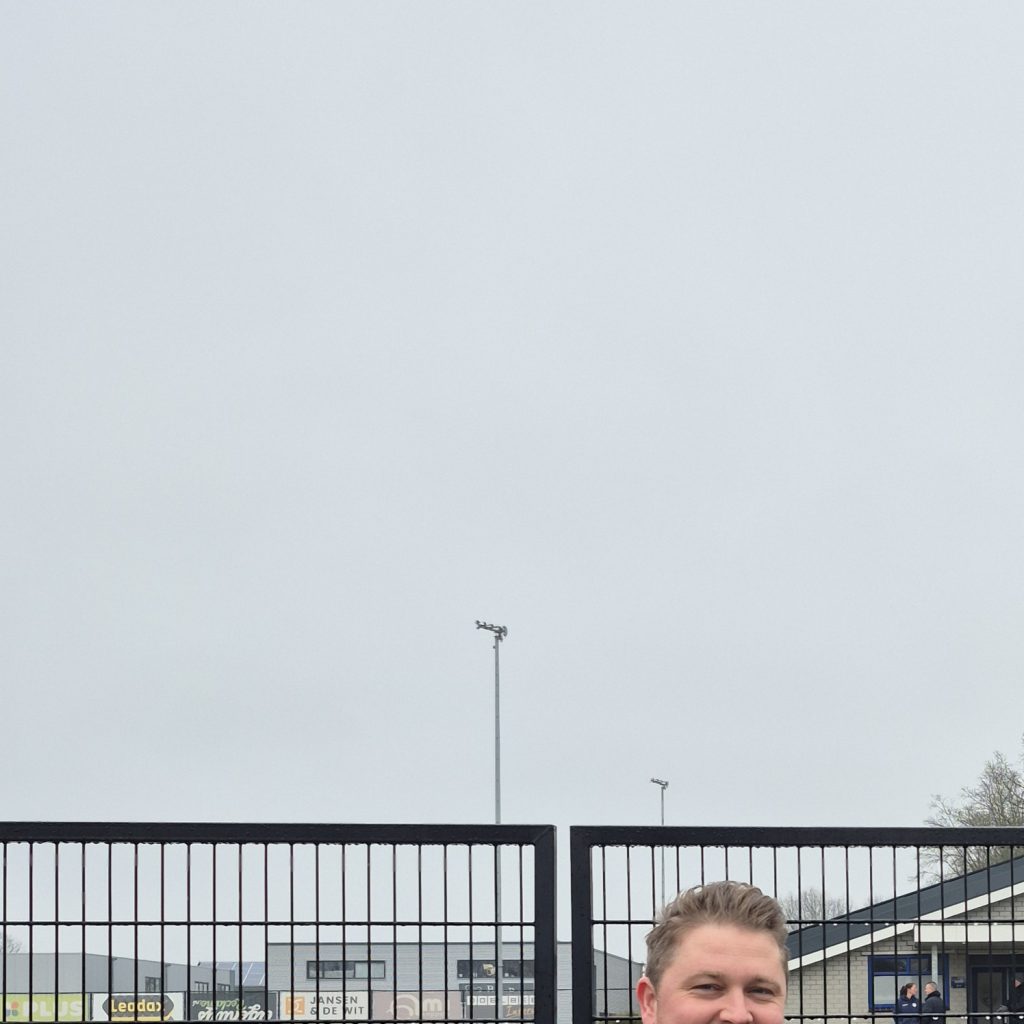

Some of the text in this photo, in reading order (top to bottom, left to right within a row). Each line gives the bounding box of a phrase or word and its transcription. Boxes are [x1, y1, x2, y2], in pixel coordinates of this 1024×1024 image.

[310, 996, 358, 1005] JANSEN
[23, 1000, 82, 1017] PLUS
[323, 1006, 337, 1015] DE
